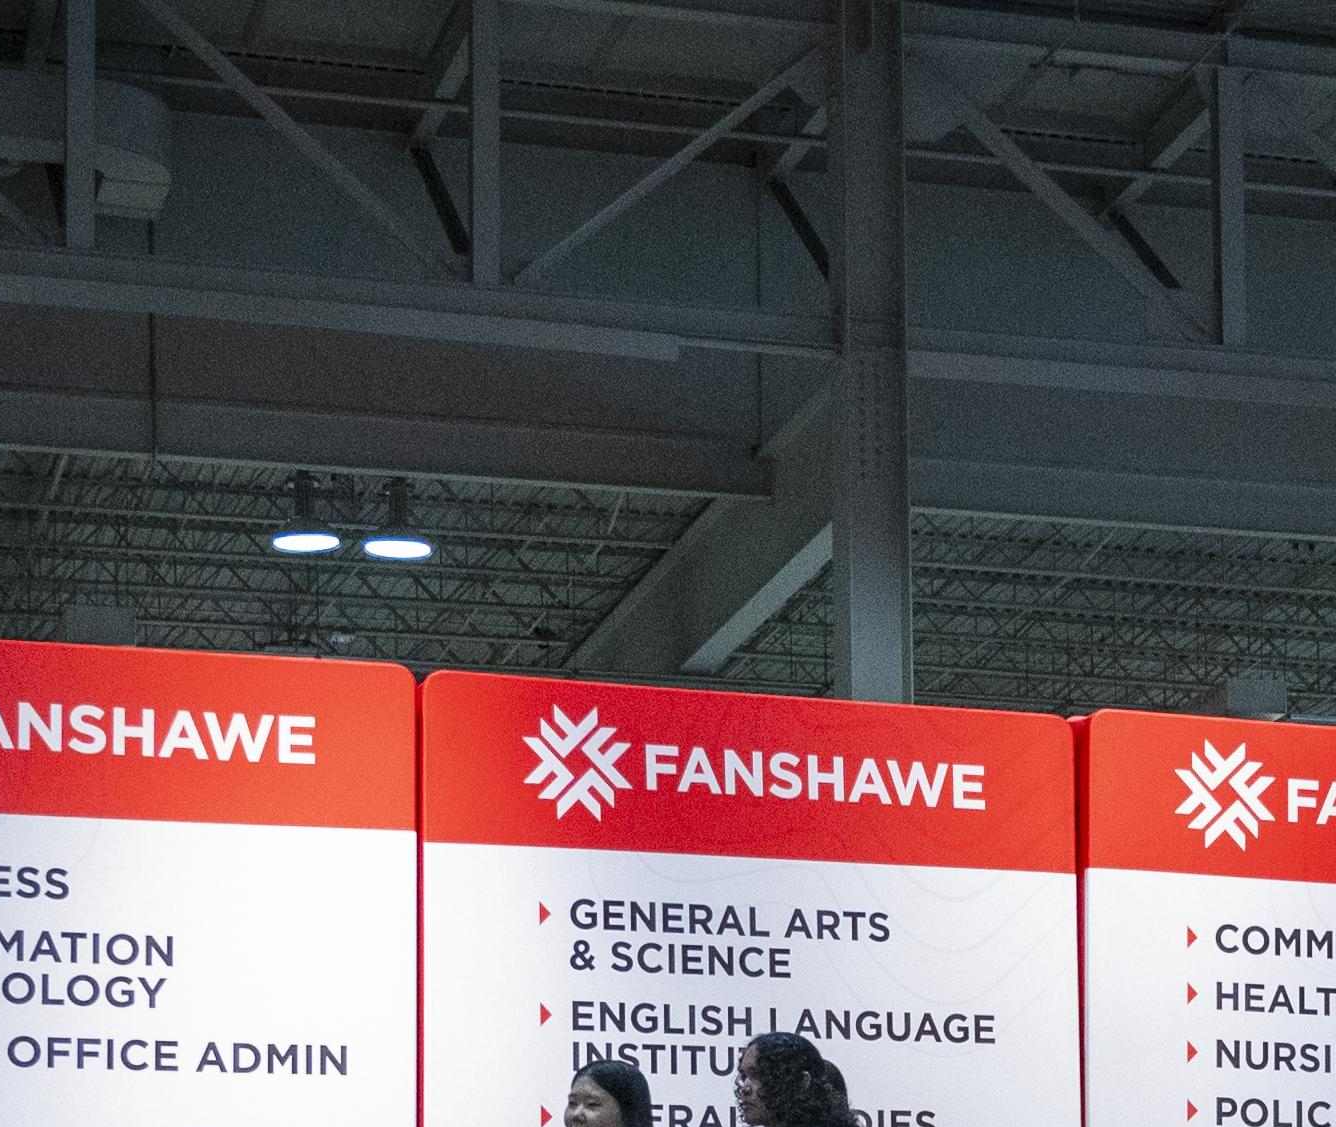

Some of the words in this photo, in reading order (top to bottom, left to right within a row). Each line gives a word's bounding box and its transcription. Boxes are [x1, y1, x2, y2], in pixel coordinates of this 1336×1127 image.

[646, 744, 985, 810] FANSHAWE
[571, 899, 769, 937] GENERAL
[784, 909, 889, 942] ARTS
[570, 940, 595, 970] &
[612, 942, 791, 978] SCIENCE
[573, 1001, 752, 1036] ENGLISH
[8, 1036, 178, 1071] OFFICE
[196, 1042, 346, 1075] ADMIN
